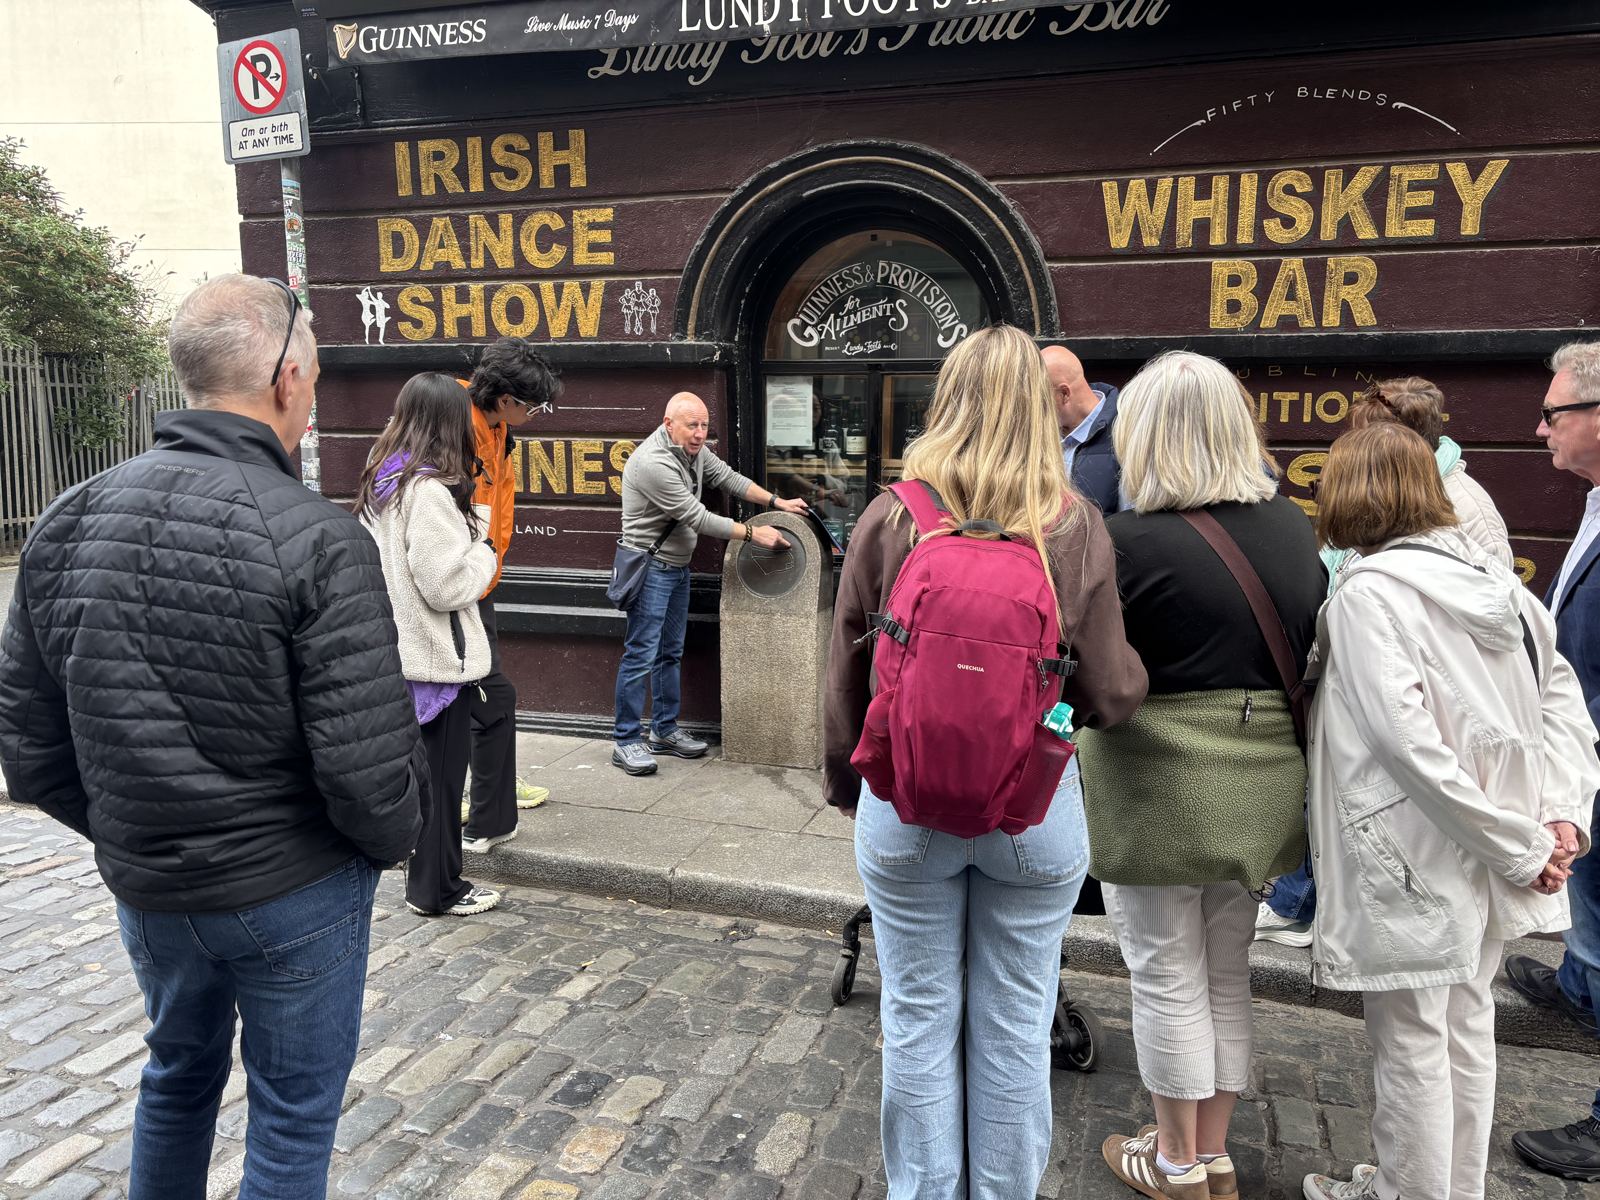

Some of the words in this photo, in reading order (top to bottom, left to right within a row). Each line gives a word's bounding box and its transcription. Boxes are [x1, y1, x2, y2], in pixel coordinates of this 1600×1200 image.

[359, 19, 487, 53] GUINNESS
[524, 16, 553, 33] Live
[553, 13, 592, 31] Music
[594, 15, 601, 29] 7
[604, 9, 639, 33] Days
[1206, 90, 1275, 121] FIFTY
[1297, 86, 1388, 106] BLENDS
[238, 140, 249, 151] AT
[252, 137, 270, 149] ANY
[273, 133, 295, 146] TIME
[394, 128, 587, 197] IRISH
[1101, 159, 1510, 249] WHISKEY
[377, 207, 615, 272] DANCE
[787, 265, 864, 347] GUINNESS
[865, 264, 875, 283] &
[877, 261, 968, 348] PROVISIONS
[839, 295, 861, 316] for
[1209, 255, 1379, 329] BAR
[397, 280, 606, 340] SHOW
[1237, 365, 1374, 384] UBLIN
[957, 663, 985, 673] QUECHUA
